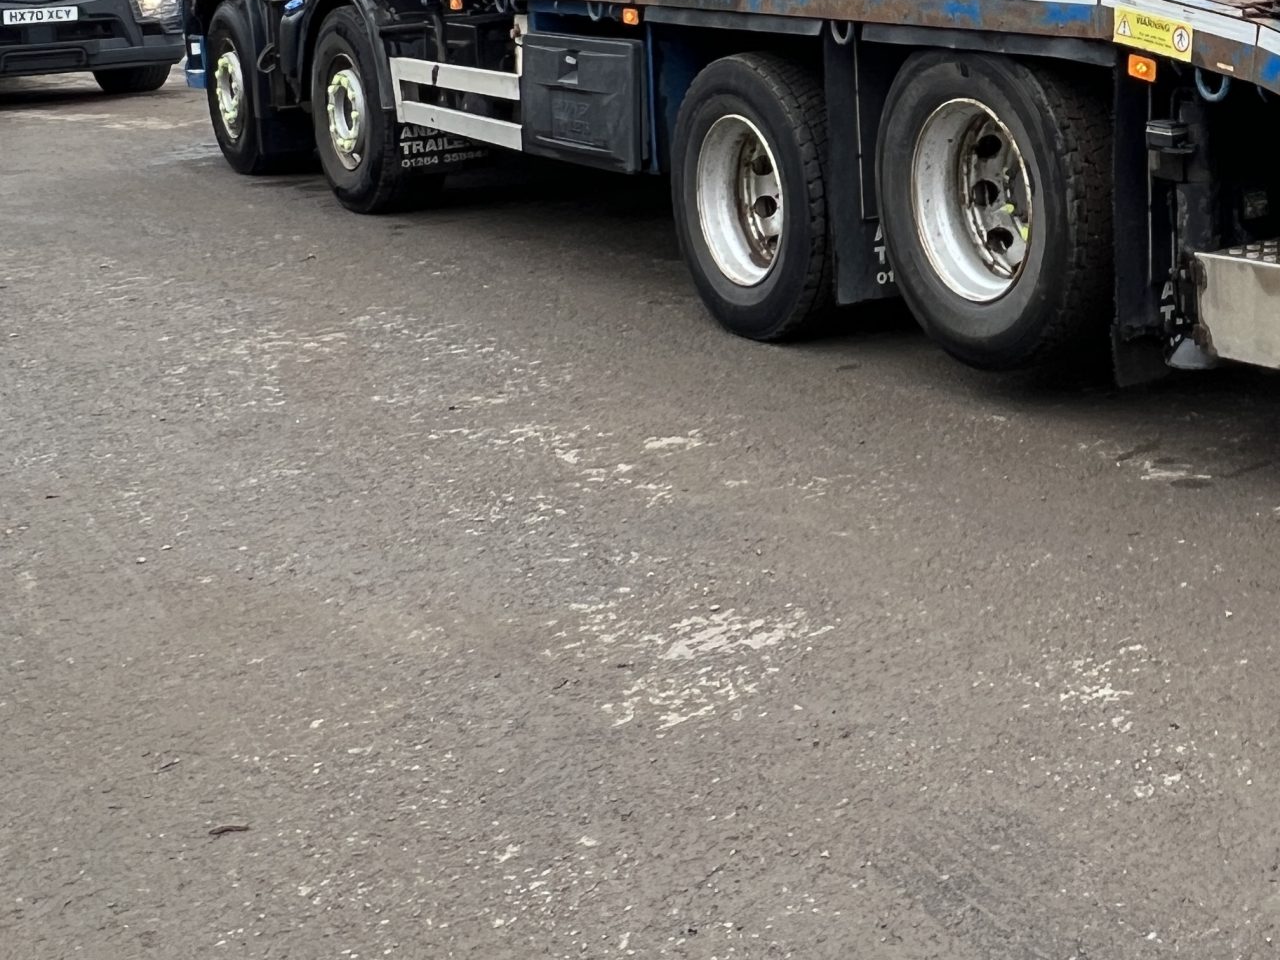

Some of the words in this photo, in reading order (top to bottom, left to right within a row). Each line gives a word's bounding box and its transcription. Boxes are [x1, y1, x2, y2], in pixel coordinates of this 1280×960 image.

[9, 10, 44, 22] HX70
[47, 9, 72, 20] XCY
[399, 137, 471, 155] TRAILE
